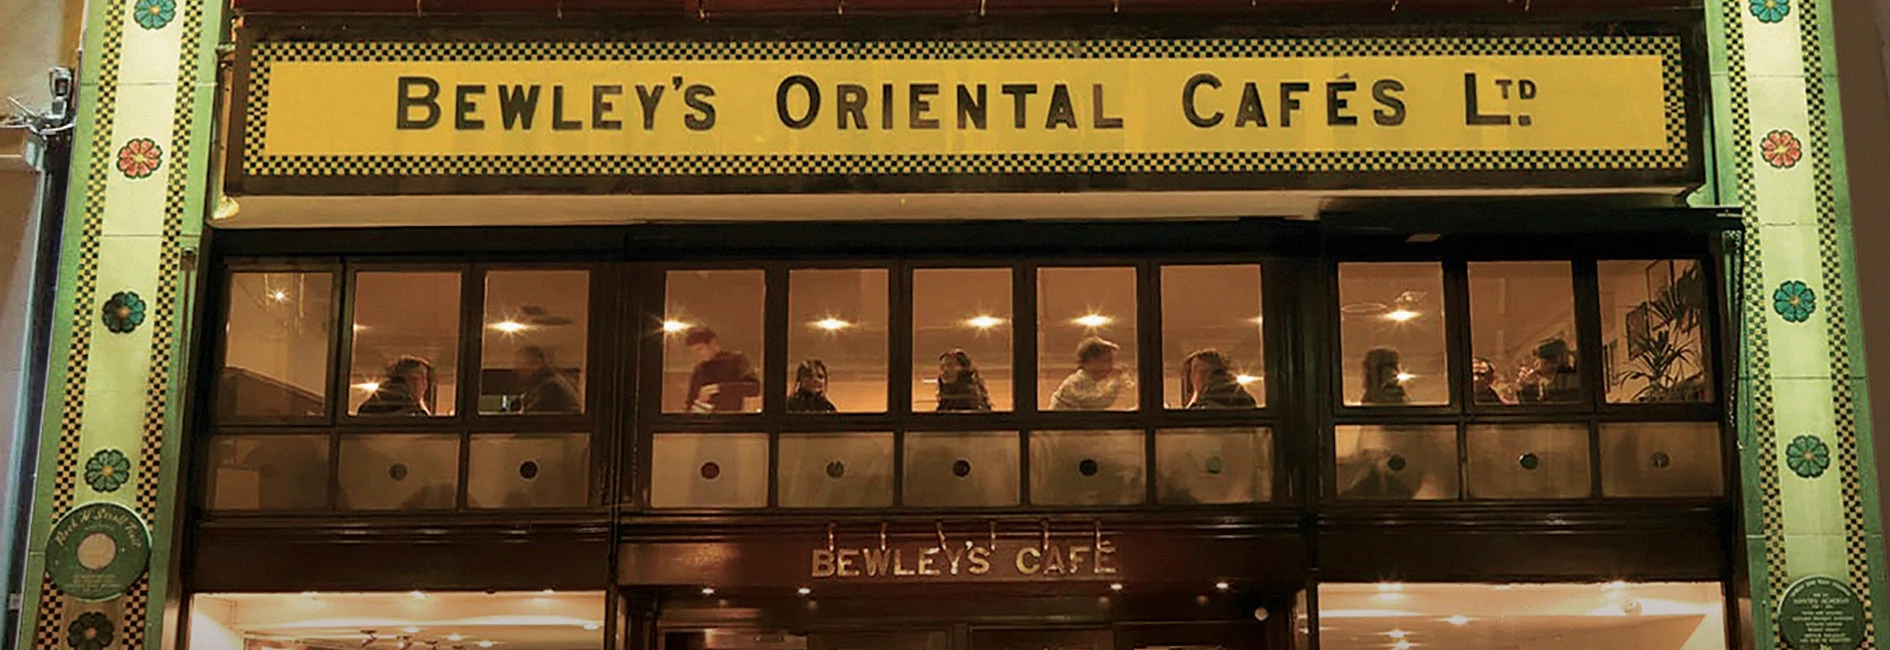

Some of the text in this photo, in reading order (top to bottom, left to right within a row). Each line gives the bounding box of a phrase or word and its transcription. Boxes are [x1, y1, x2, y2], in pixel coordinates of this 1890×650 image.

[396, 76, 717, 131] BEWLEY'S
[775, 74, 1124, 130] ORIENTAL
[1182, 73, 1407, 128] CAFÉS
[811, 540, 991, 578] BEWLEY'S
